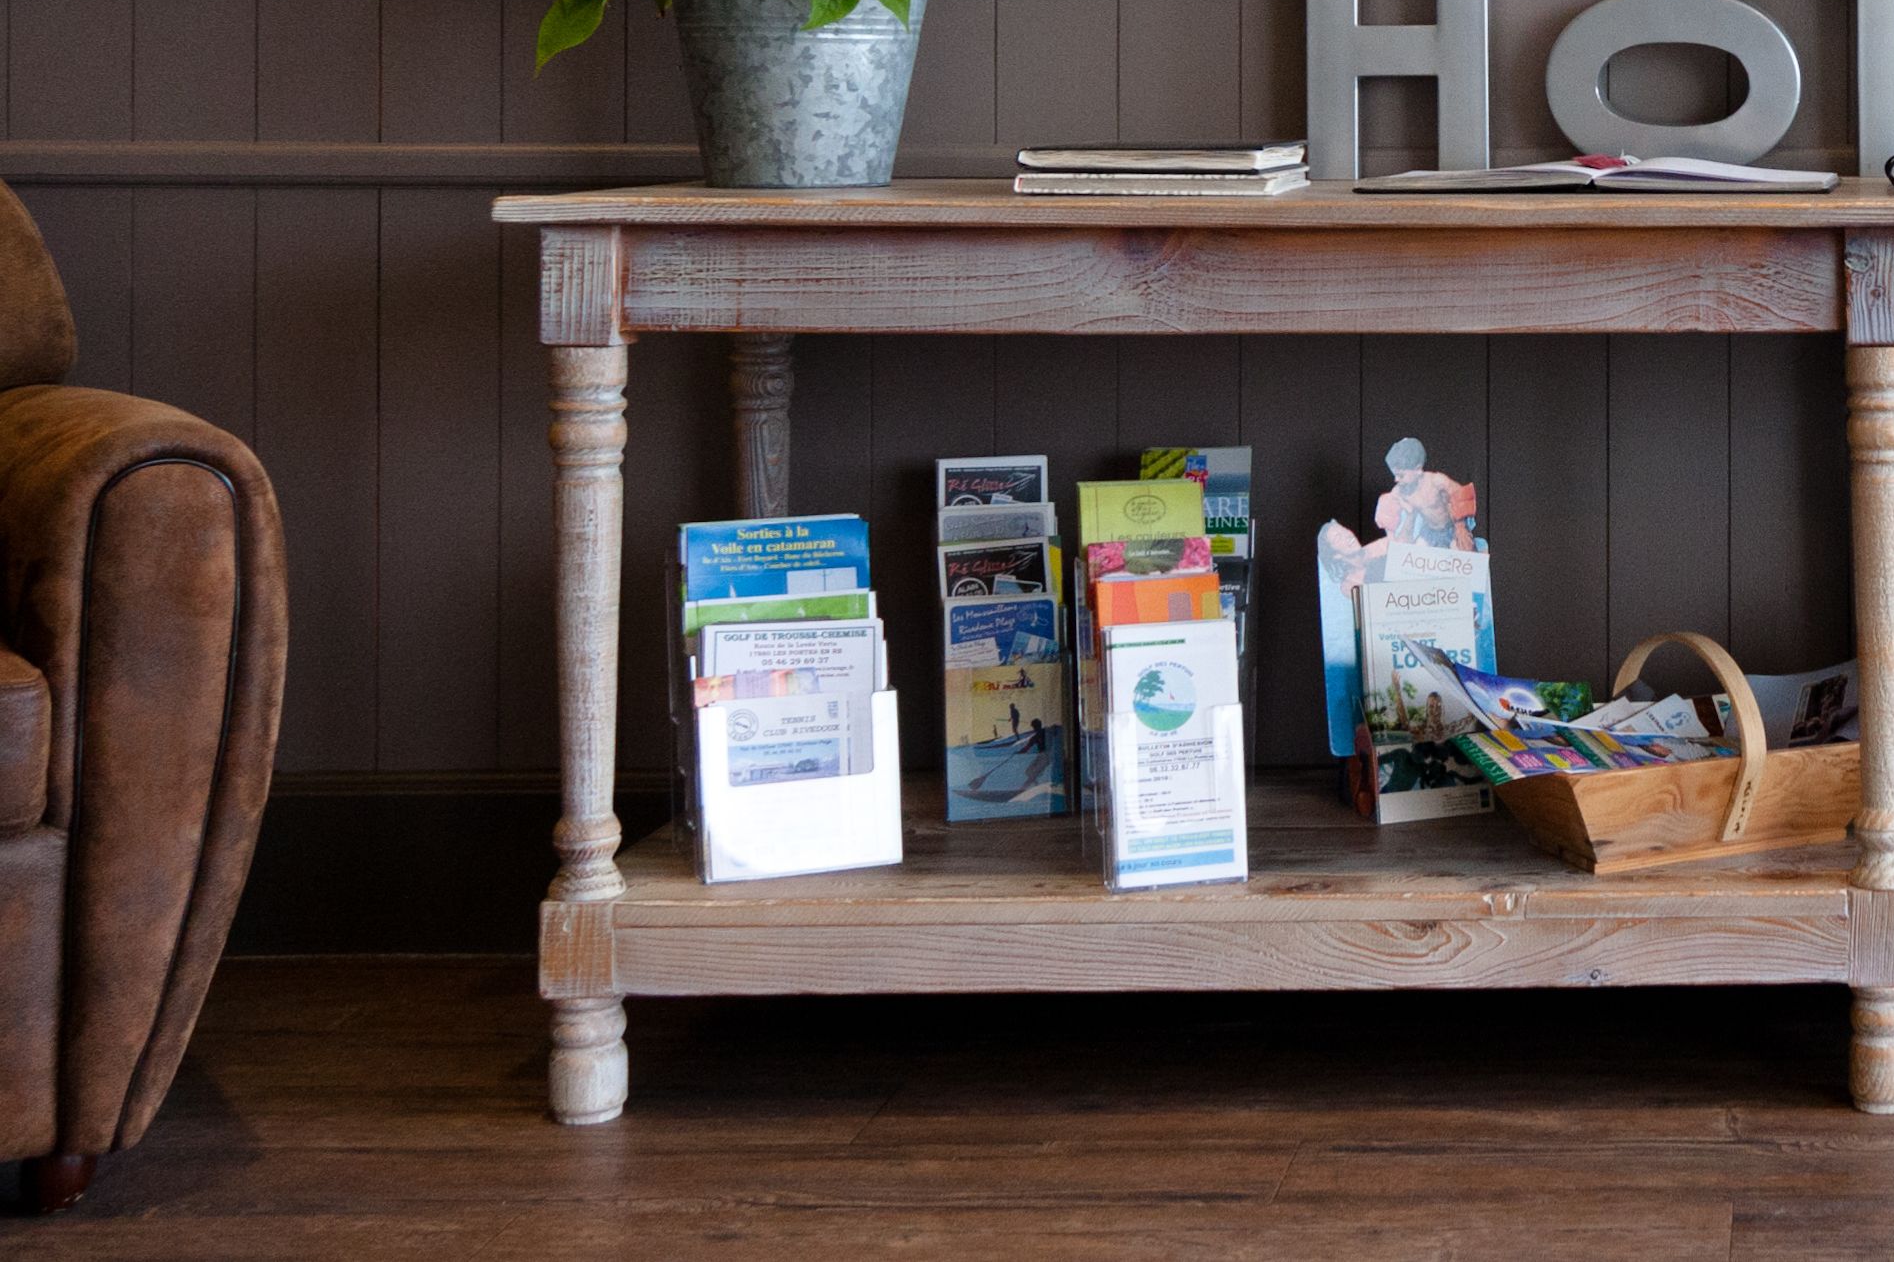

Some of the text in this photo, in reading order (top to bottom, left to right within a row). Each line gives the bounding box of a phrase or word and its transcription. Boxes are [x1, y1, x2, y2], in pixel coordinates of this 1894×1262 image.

[1207, 517, 1249, 529] EINES
[736, 525, 809, 541] Sorties à la
[711, 539, 835, 555] Voile en catamaran
[724, 630, 867, 642] GOLF DE TROUSSE-CHEMISE
[1391, 639, 1437, 652] SPRT
